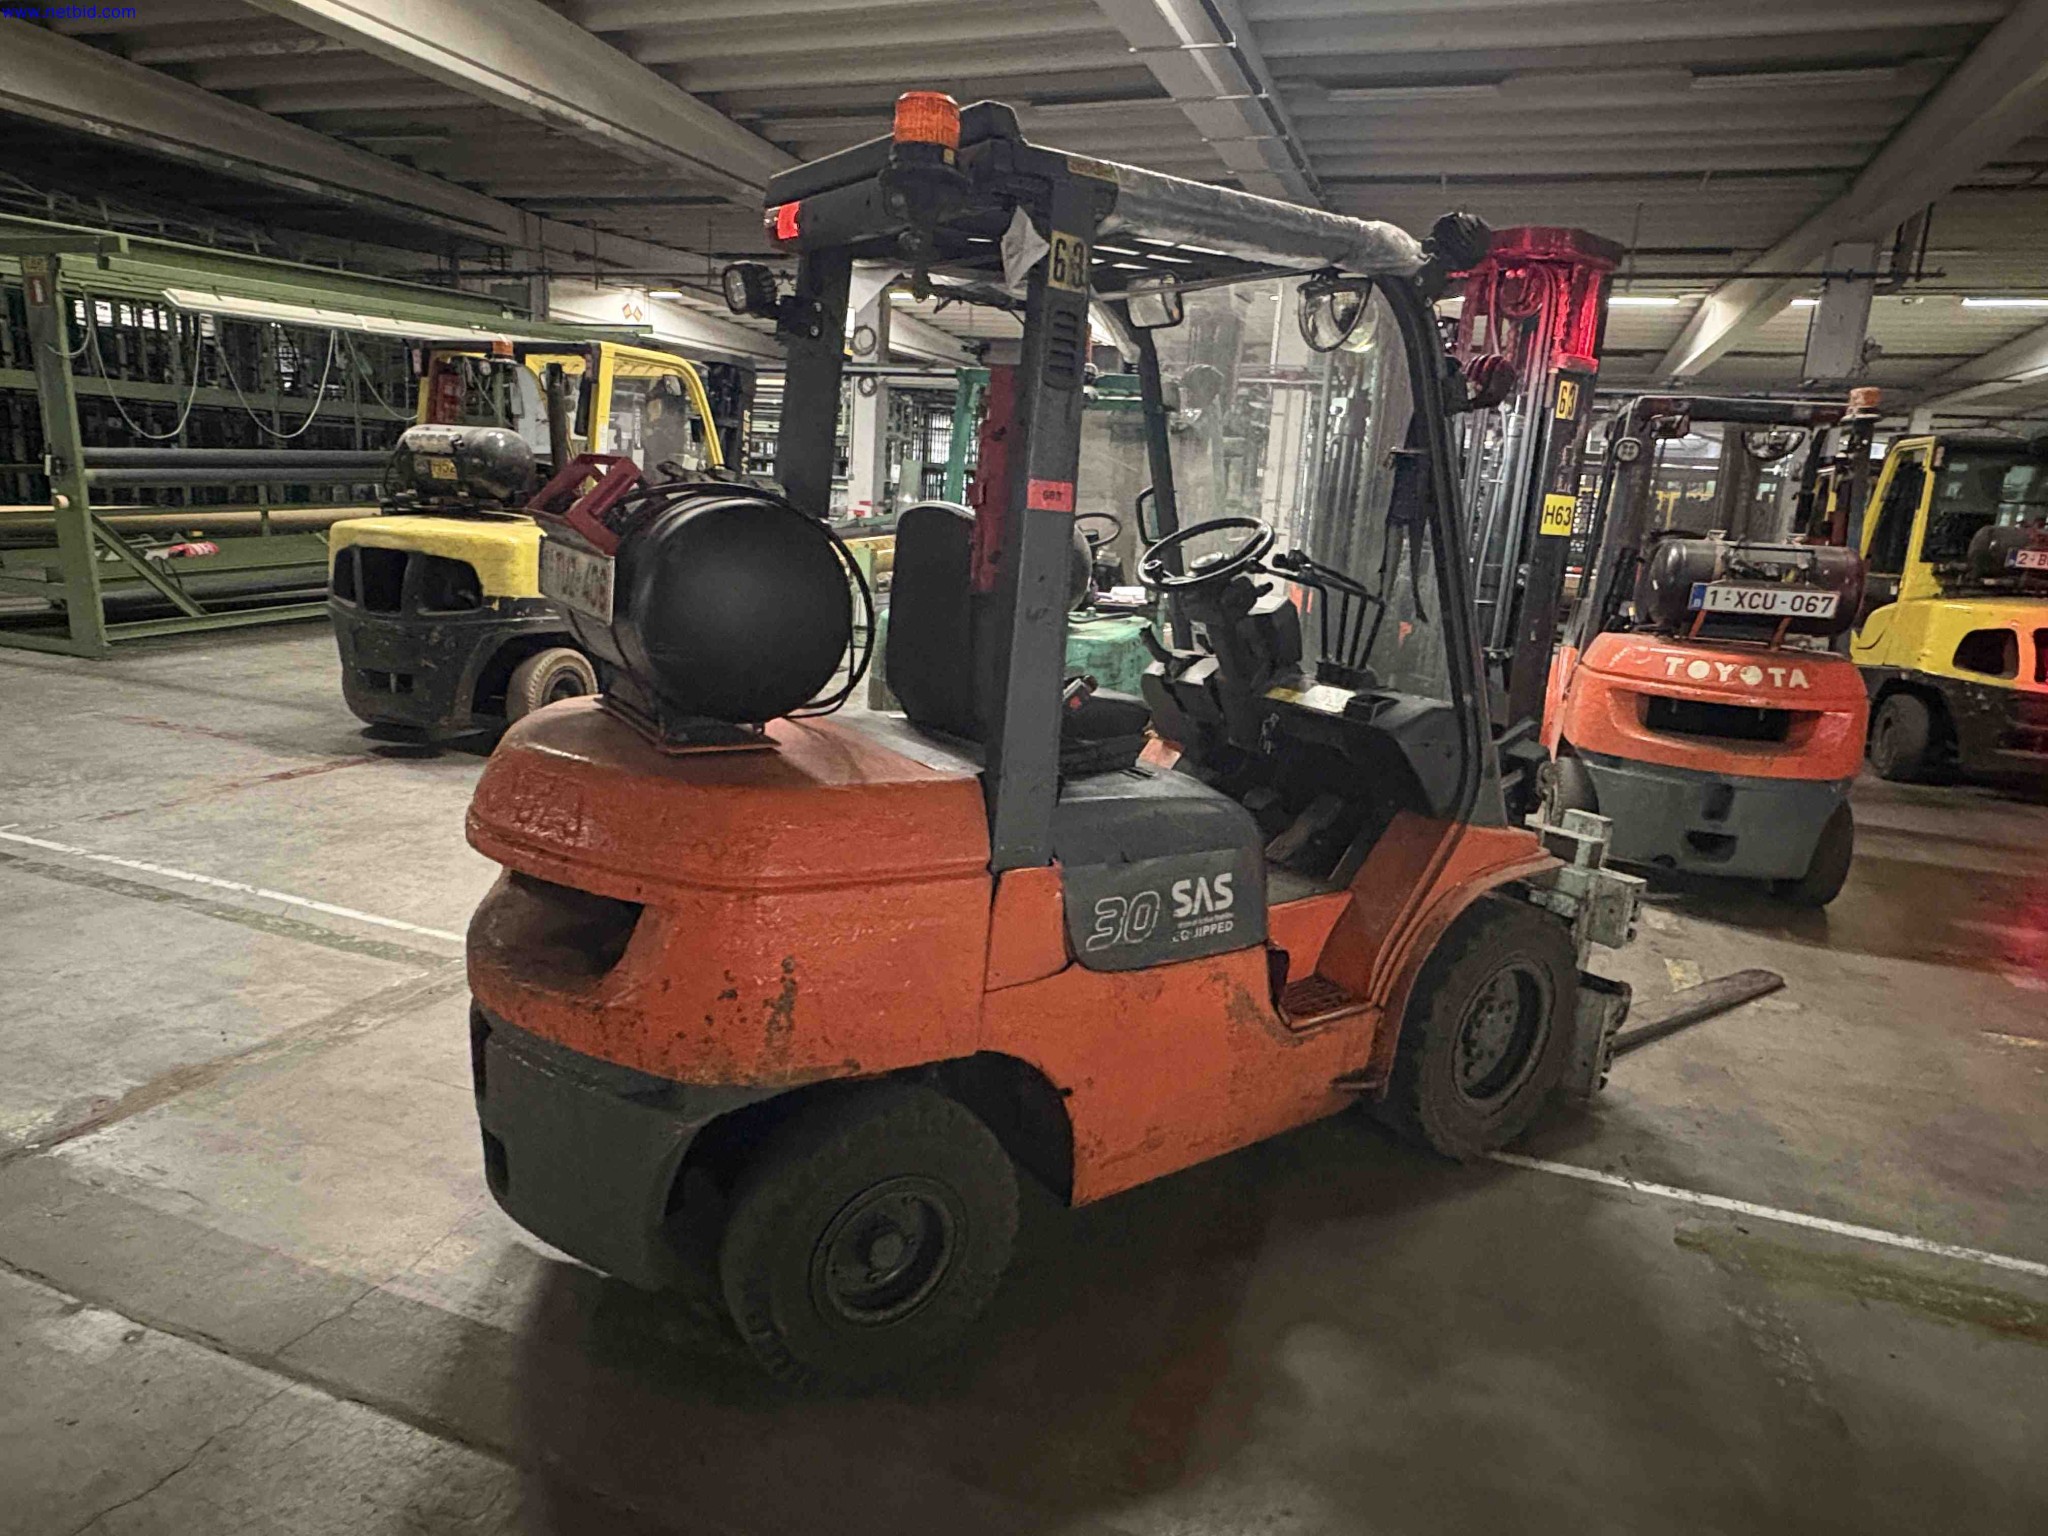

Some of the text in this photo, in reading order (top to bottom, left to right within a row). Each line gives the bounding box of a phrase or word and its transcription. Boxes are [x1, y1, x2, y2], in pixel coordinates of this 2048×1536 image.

[1558, 384, 1577, 418] 63
[1543, 504, 1572, 526] H63
[2017, 553, 2048, 566] 2-B
[1664, 656, 1810, 689] TOYOTA
[1172, 872, 1234, 918] SAS
[1086, 890, 1161, 951] 30
